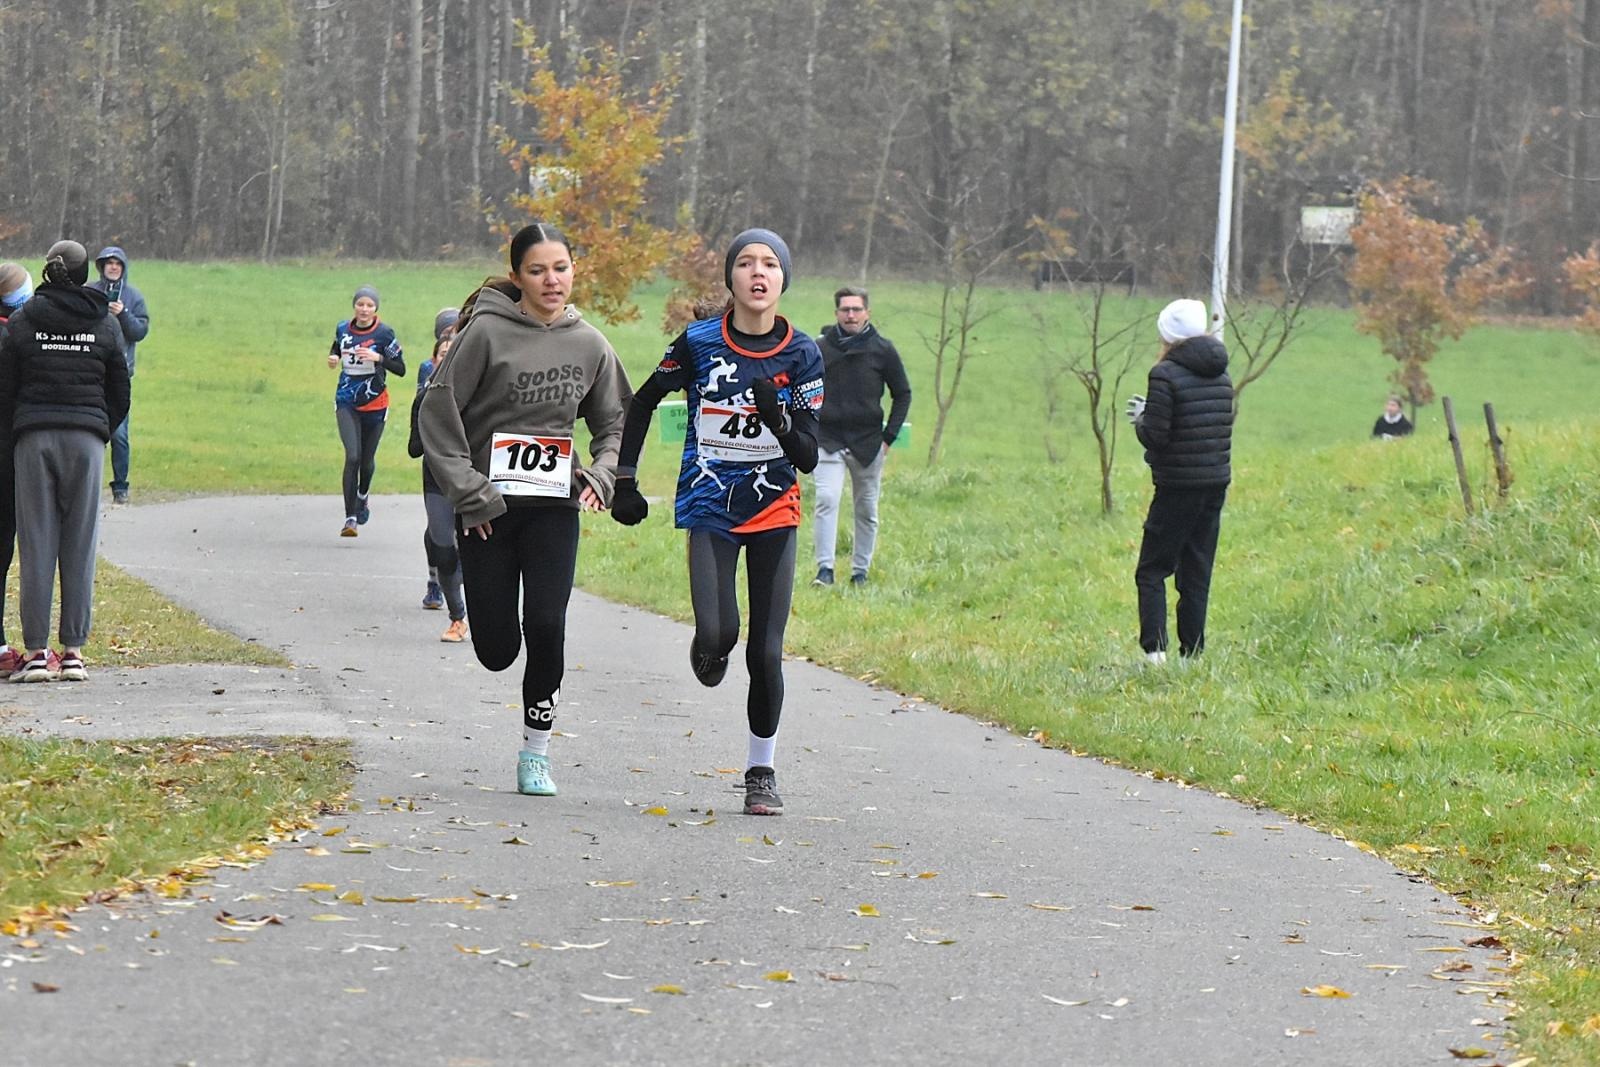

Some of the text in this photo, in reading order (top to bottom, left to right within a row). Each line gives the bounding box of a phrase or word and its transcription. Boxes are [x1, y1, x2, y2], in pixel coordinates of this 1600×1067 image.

[35, 332, 48, 341] KS
[70, 333, 95, 343] TEAM
[516, 365, 583, 389] goose
[505, 382, 585, 406] bumps
[719, 413, 762, 439] 48
[507, 443, 559, 472] 103
